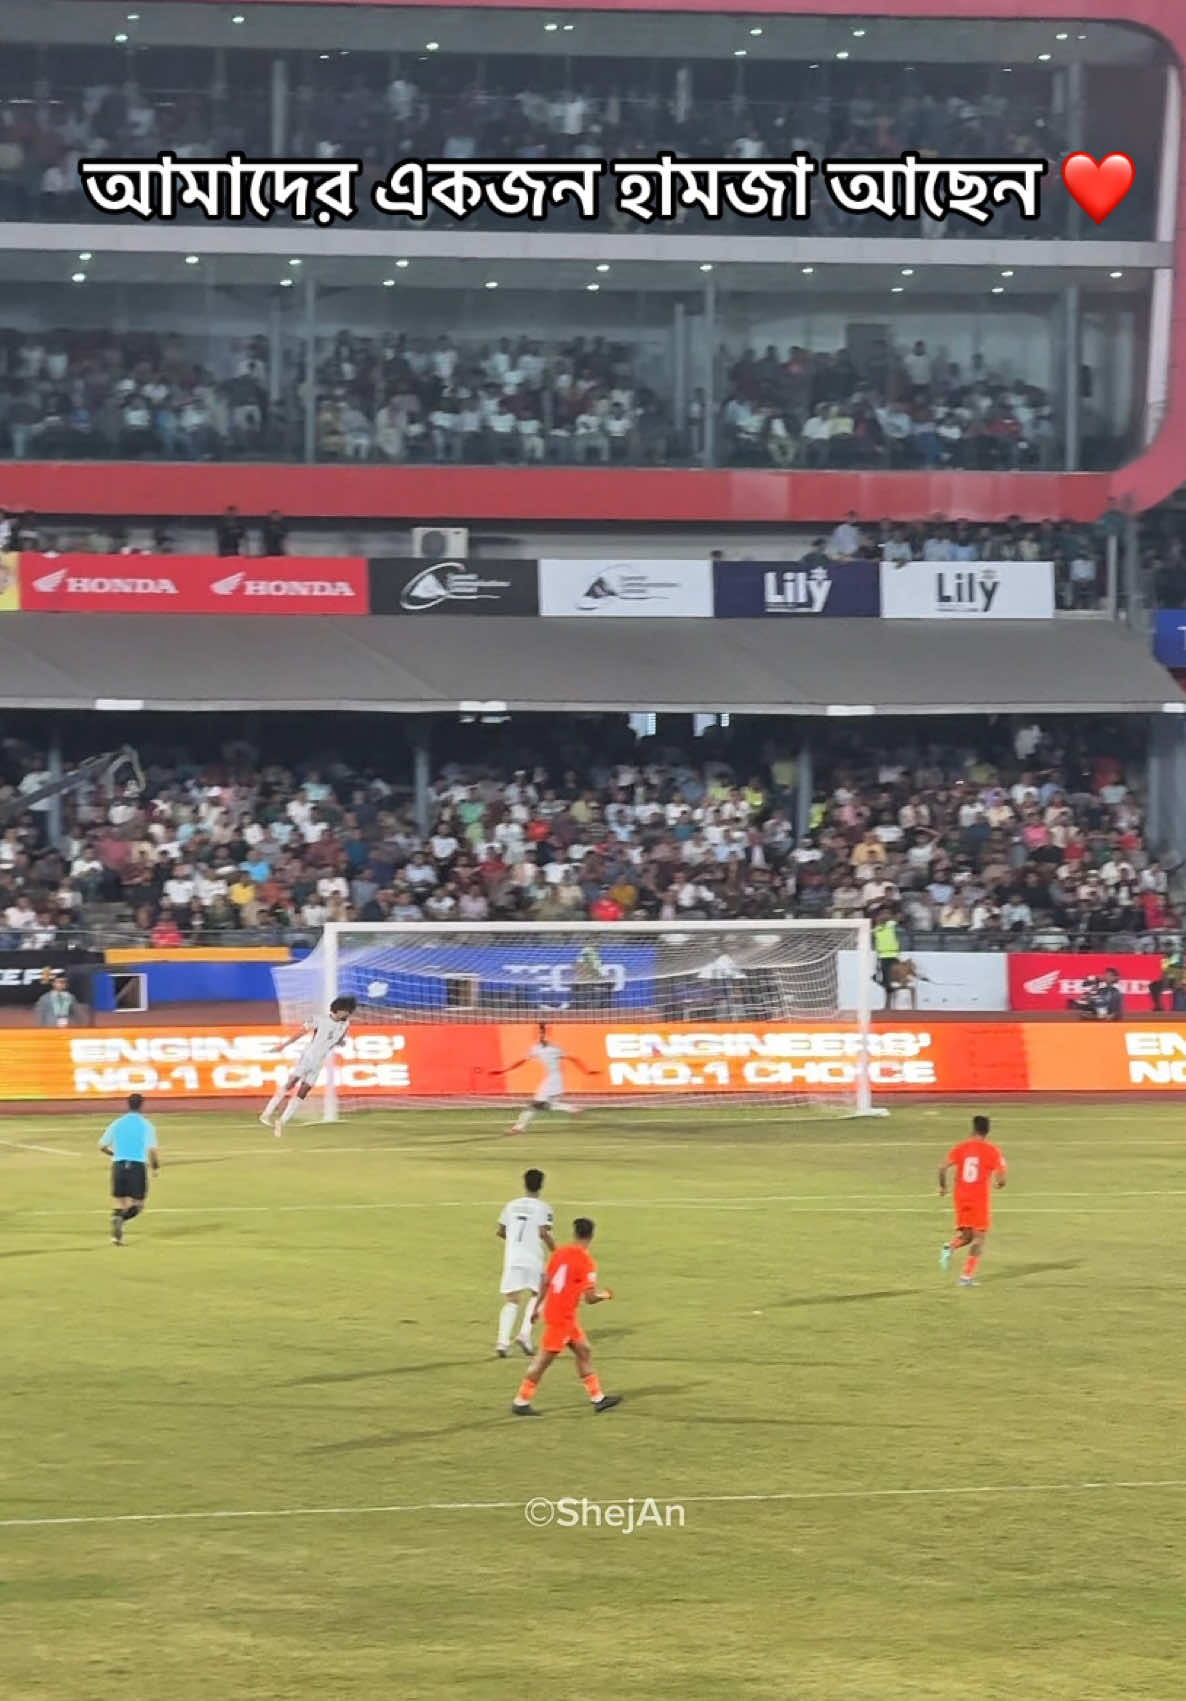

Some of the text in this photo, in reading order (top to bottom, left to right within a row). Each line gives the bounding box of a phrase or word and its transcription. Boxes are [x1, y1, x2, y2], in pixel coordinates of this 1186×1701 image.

[66, 577, 179, 594] HONDA
[244, 580, 355, 596] HONDA
[764, 569, 832, 612] Lily
[936, 571, 999, 612] Lily
[1059, 979, 1160, 995] HND
[73, 1064, 410, 1092] NO.1 CHCE
[608, 1062, 730, 1085] NO.1
[962, 1156, 979, 1183] 6
[516, 1215, 528, 1242] 7
[551, 1264, 569, 1294] 4
